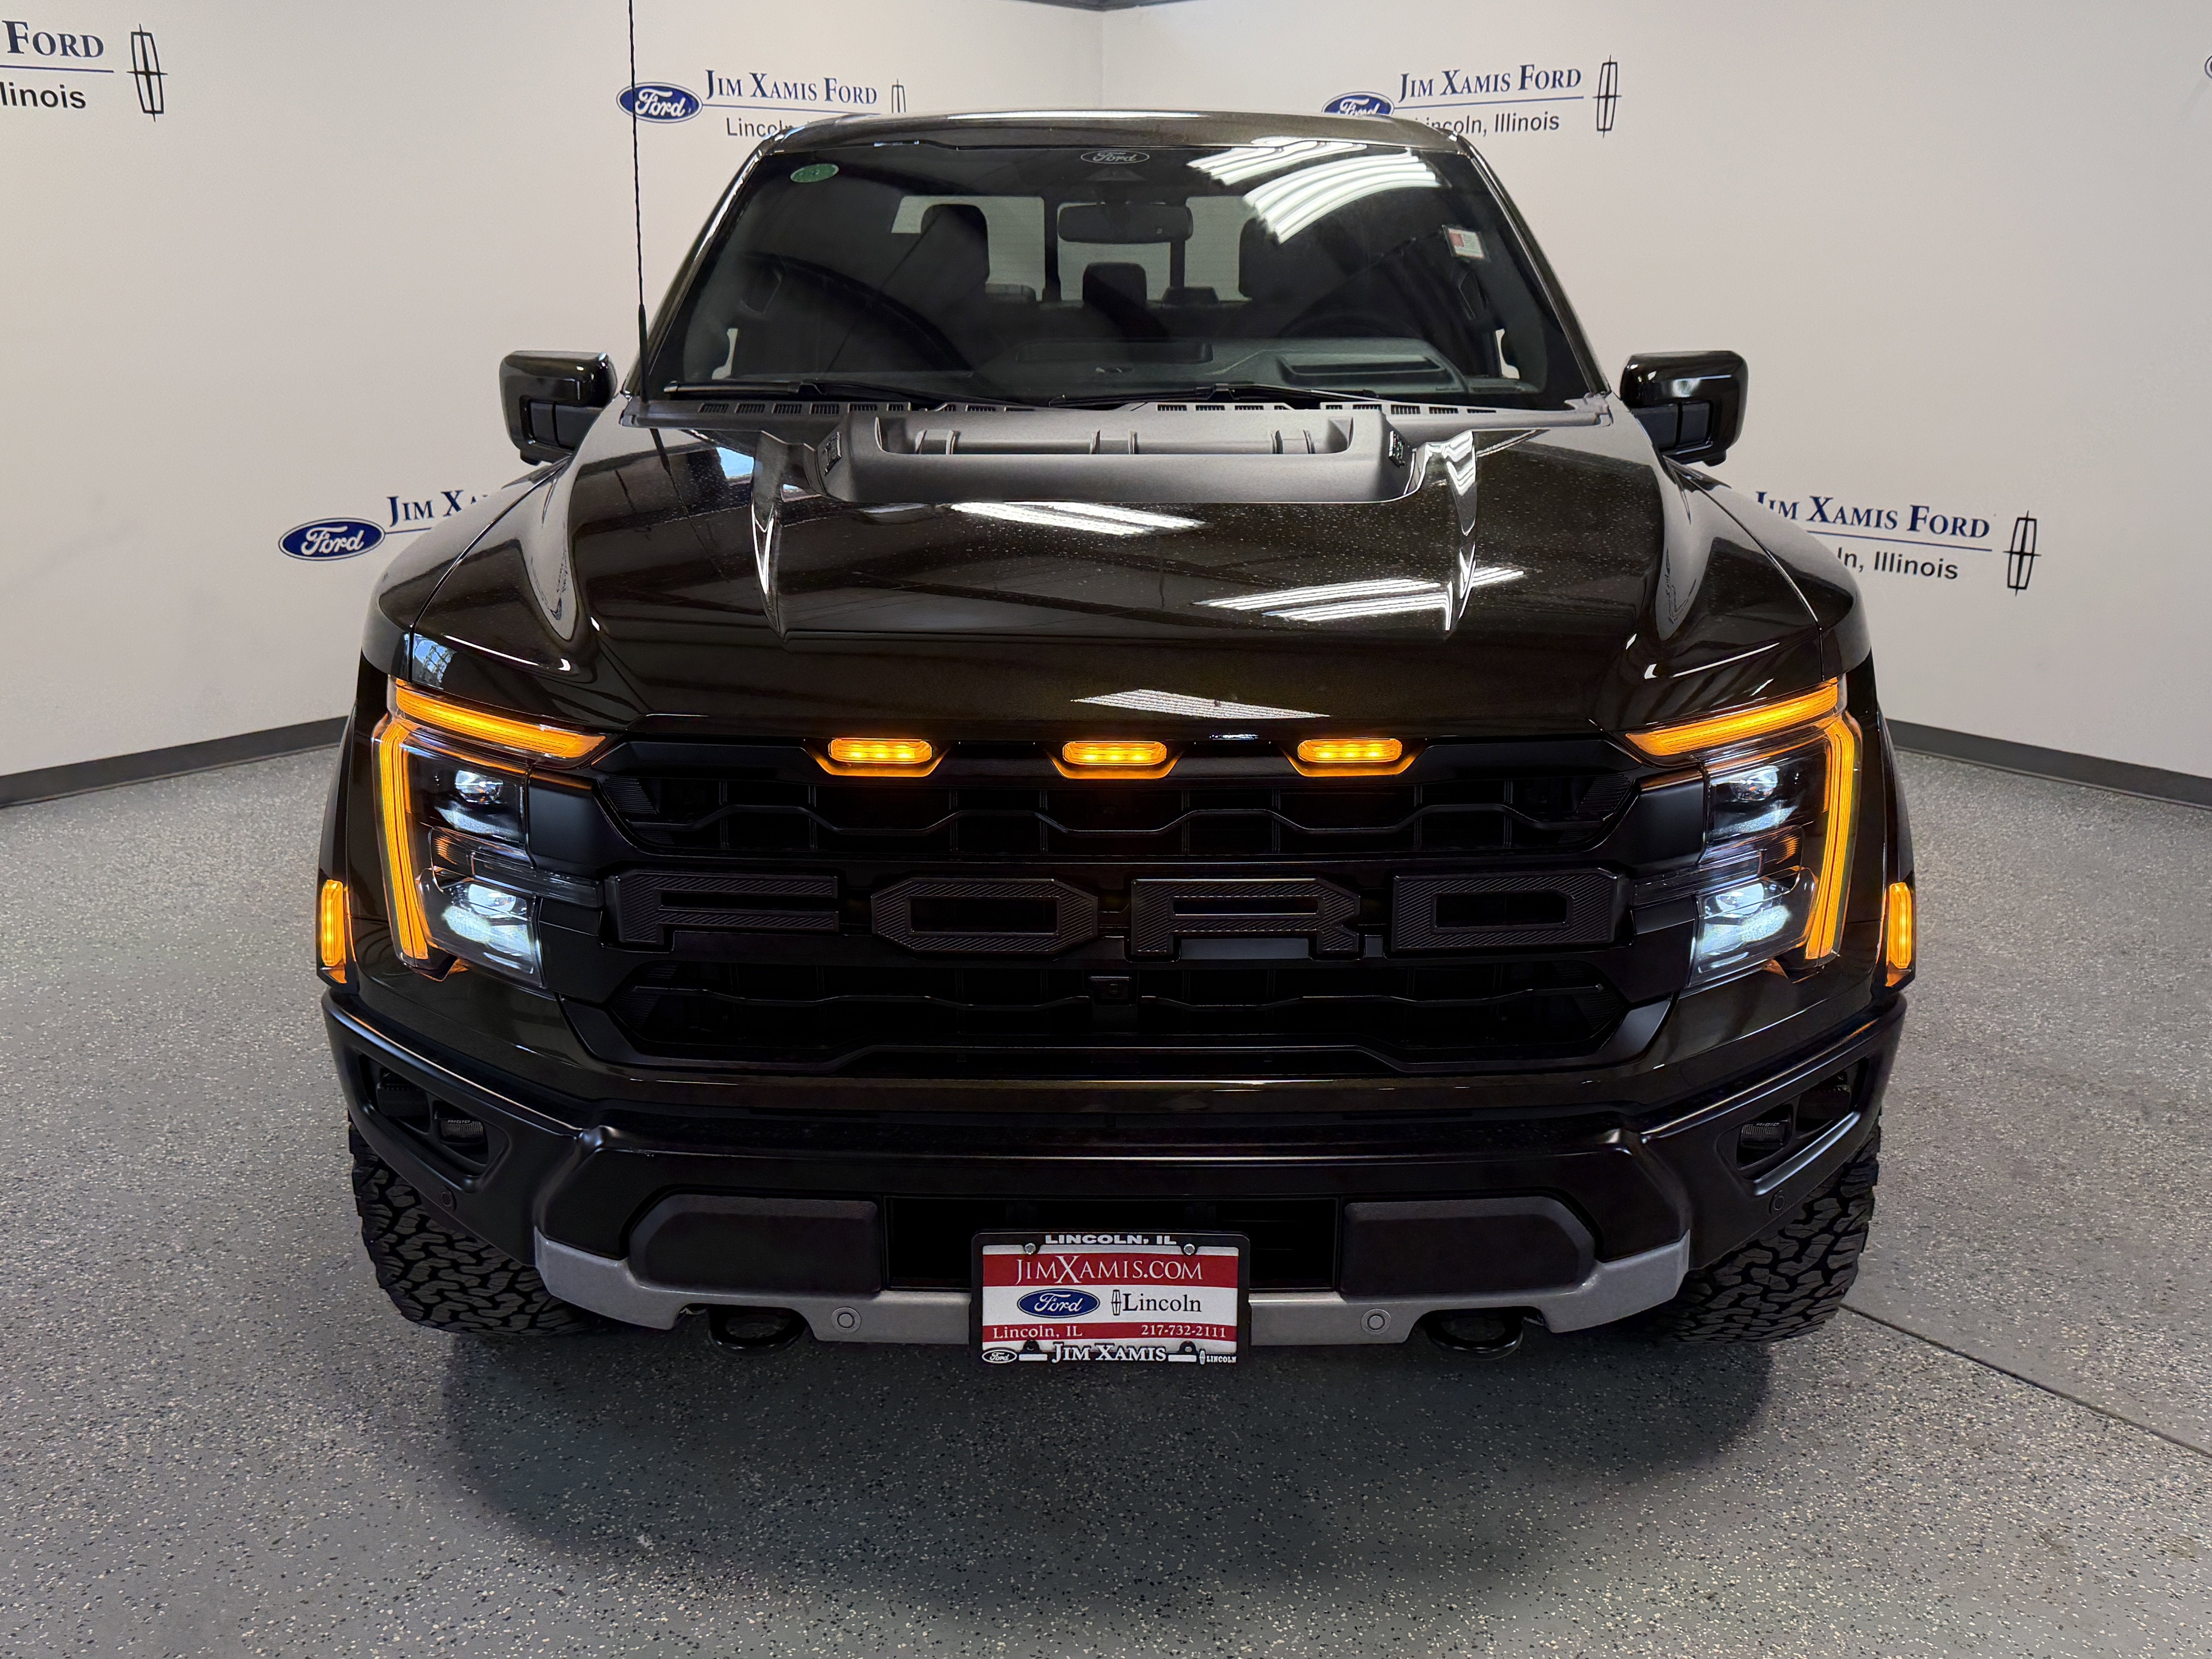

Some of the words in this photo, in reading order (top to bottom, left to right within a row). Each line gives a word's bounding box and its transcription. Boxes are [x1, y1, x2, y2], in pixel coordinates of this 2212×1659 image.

[2, 21, 104, 58] FORD
[0, 82, 86, 109] linois
[706, 70, 743, 100] JIM
[749, 72, 817, 101] XAMIS
[823, 77, 878, 105] FORD
[1398, 73, 1434, 103] JIM
[1440, 69, 1511, 95] XAMIS
[1518, 64, 1582, 91] FORD
[635, 88, 685, 116] Ford
[726, 117, 793, 137] Lincol
[1495, 111, 1559, 133] Illinois
[1092, 152, 1137, 161] Ford
[386, 496, 435, 527] JIM
[1806, 495, 1898, 530] XAMIS
[1906, 504, 1990, 538] FORD
[301, 526, 364, 555] Ford
[1874, 551, 1958, 579] Illinois
[616, 868, 1622, 955] FORD
[1045, 1234, 1149, 1245] LINCOLN,
[1156, 1235, 1177, 1245] IL
[1015, 1255, 1204, 1285] JIMXAMIS.COM
[1034, 1293, 1083, 1312] Ford
[1123, 1293, 1202, 1312] Lincoln
[993, 1325, 1060, 1339] Lincoln,
[1066, 1326, 1082, 1337] IL
[1141, 1324, 1226, 1338] 217-732-2111
[989, 1352, 1009, 1361] Ford
[1051, 1343, 1091, 1364] JIM
[1094, 1345, 1167, 1362] XAMIS
[1207, 1355, 1237, 1364] LINCOLN
